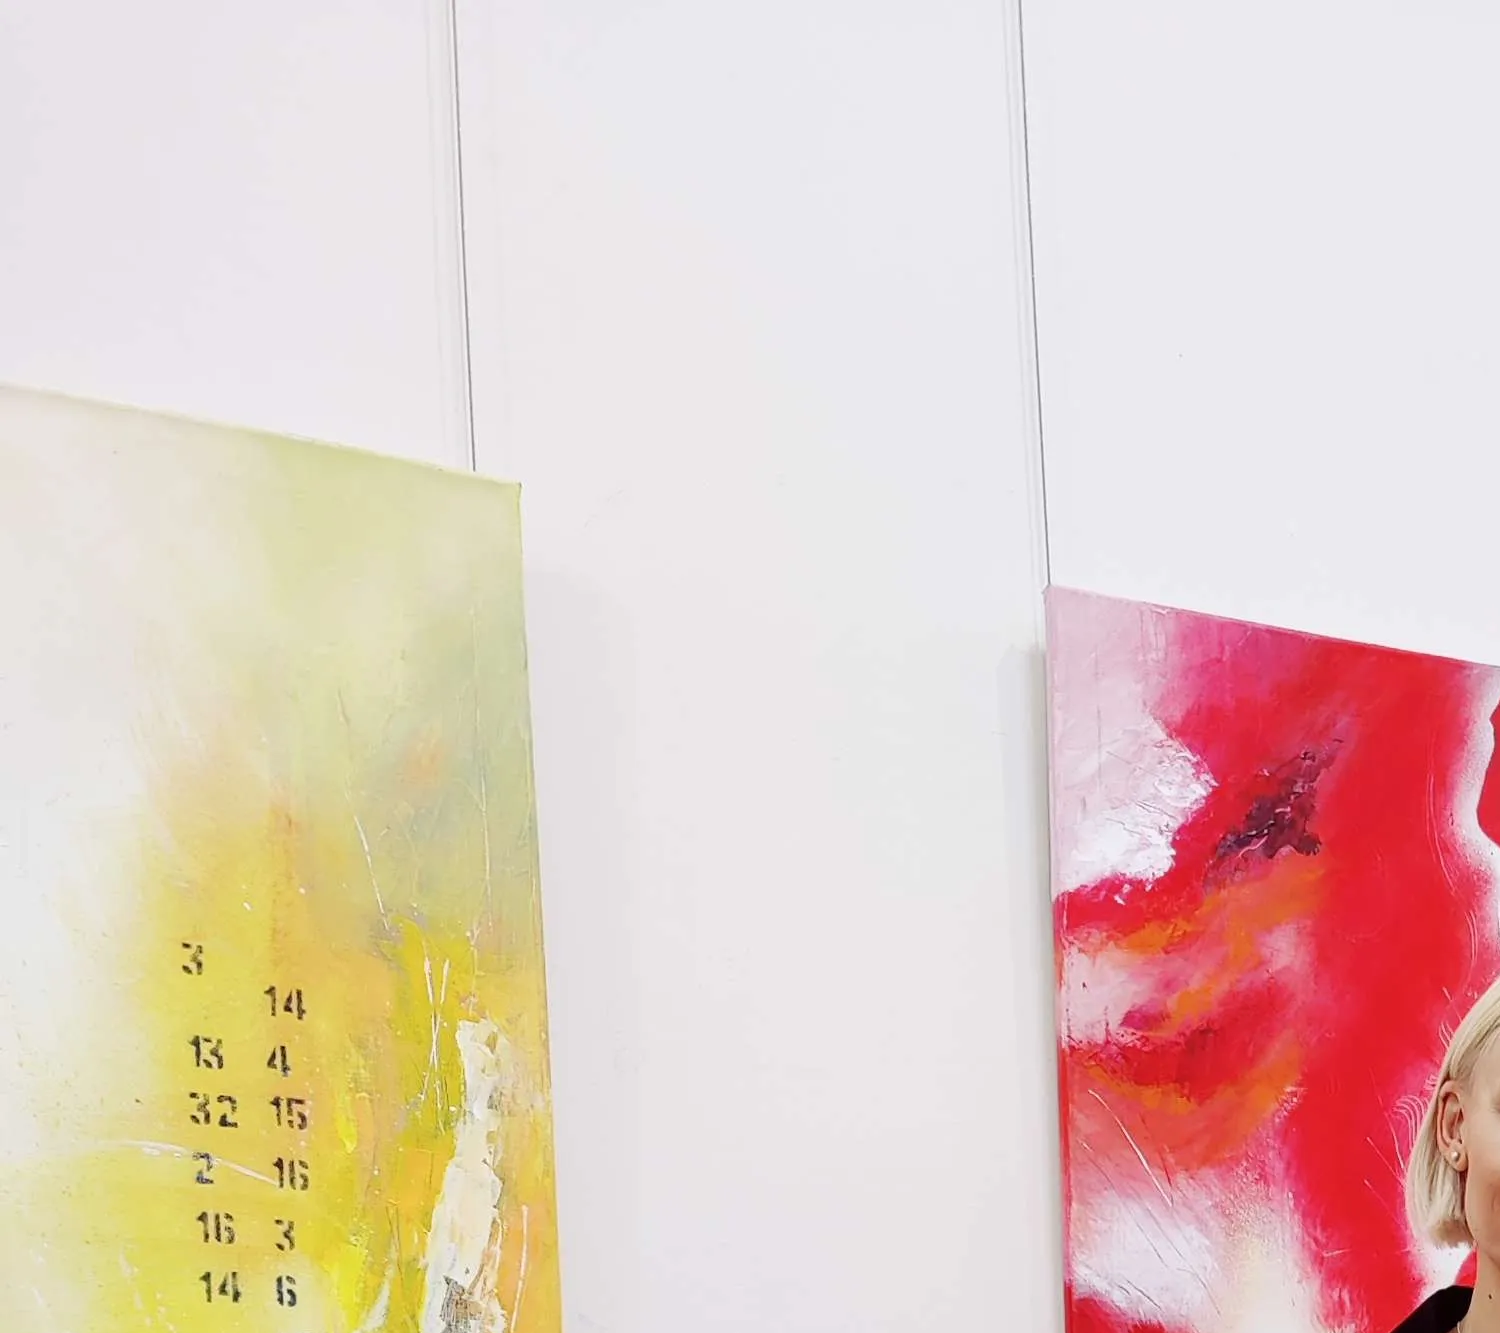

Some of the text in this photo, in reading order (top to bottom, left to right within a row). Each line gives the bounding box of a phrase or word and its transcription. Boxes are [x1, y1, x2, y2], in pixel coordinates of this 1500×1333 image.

[182, 942, 203, 976] 3
[264, 985, 307, 1021] 14
[187, 1035, 224, 1070] 13
[266, 1045, 291, 1078] 4
[269, 1096, 308, 1130] 15
[192, 1152, 215, 1185] 2
[272, 1157, 310, 1191] 16
[196, 1211, 236, 1245] 16
[274, 1219, 296, 1251] 3
[199, 1271, 242, 1304] 14
[275, 1275, 298, 1308] 6
